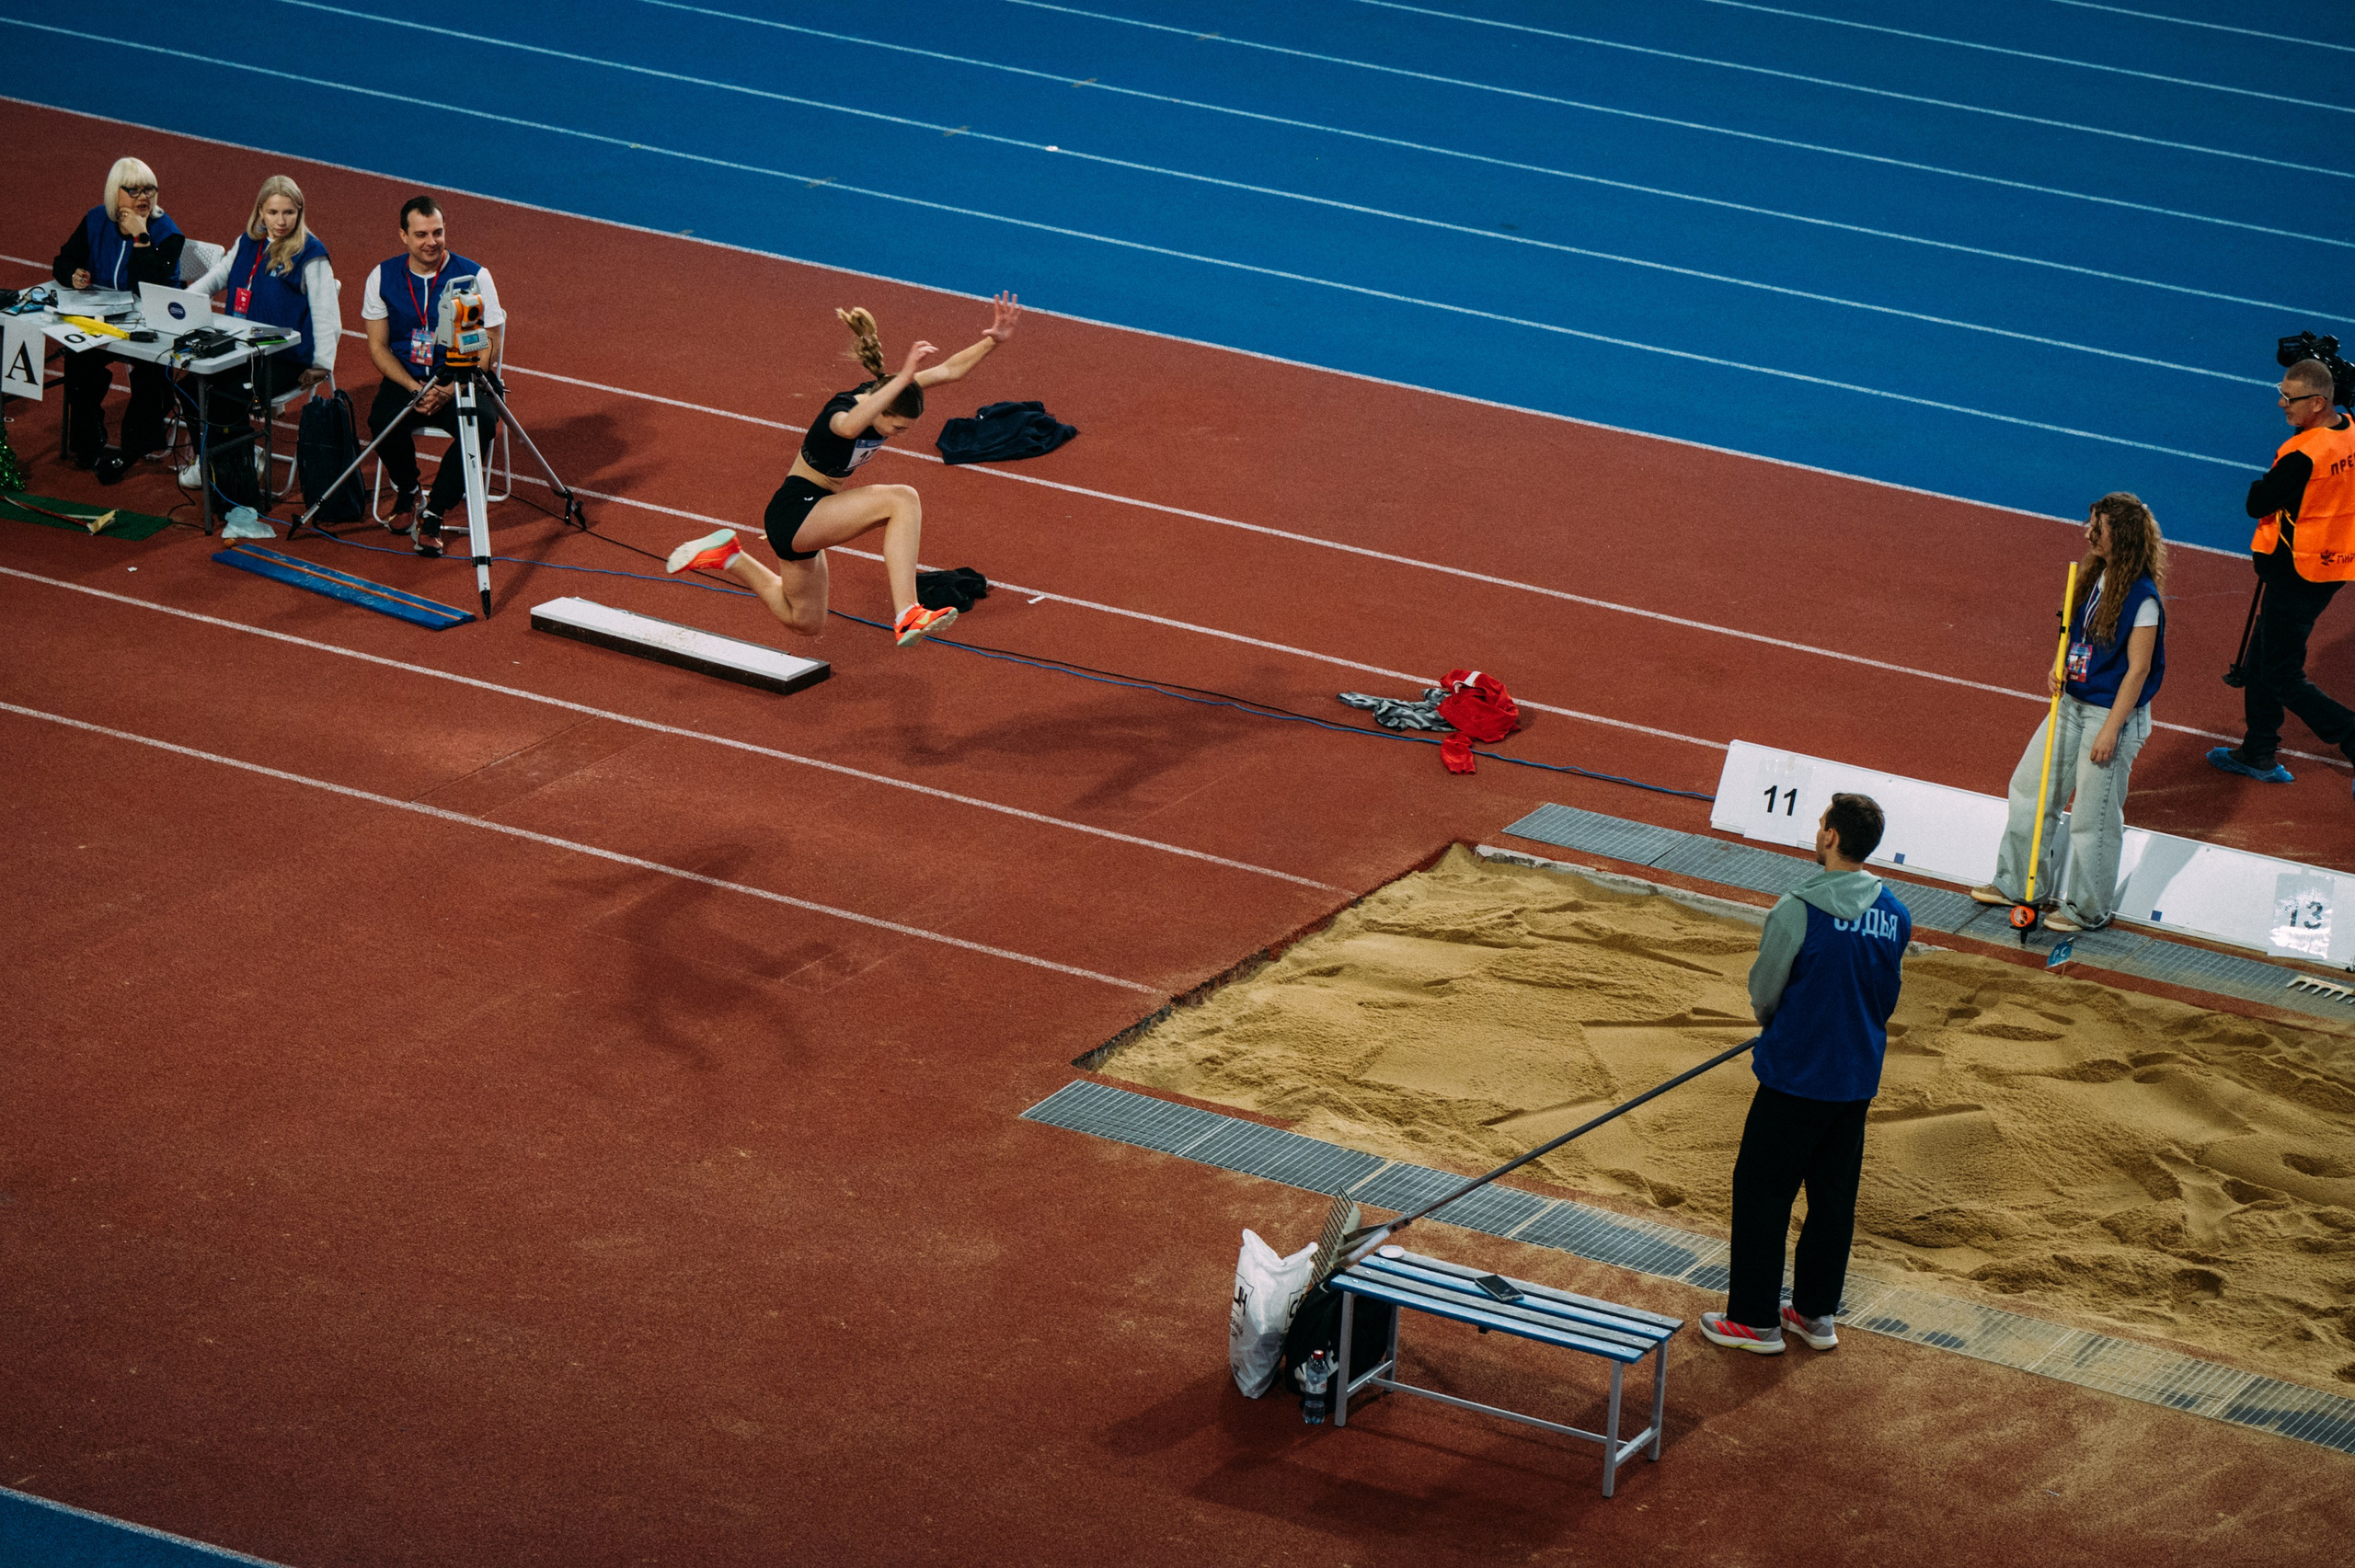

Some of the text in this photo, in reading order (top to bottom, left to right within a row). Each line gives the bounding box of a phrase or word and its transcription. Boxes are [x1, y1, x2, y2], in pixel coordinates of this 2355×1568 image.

[2330, 452, 2355, 476] ПРЕ
[1763, 785, 1798, 816] 11
[2284, 898, 2324, 930] 13
